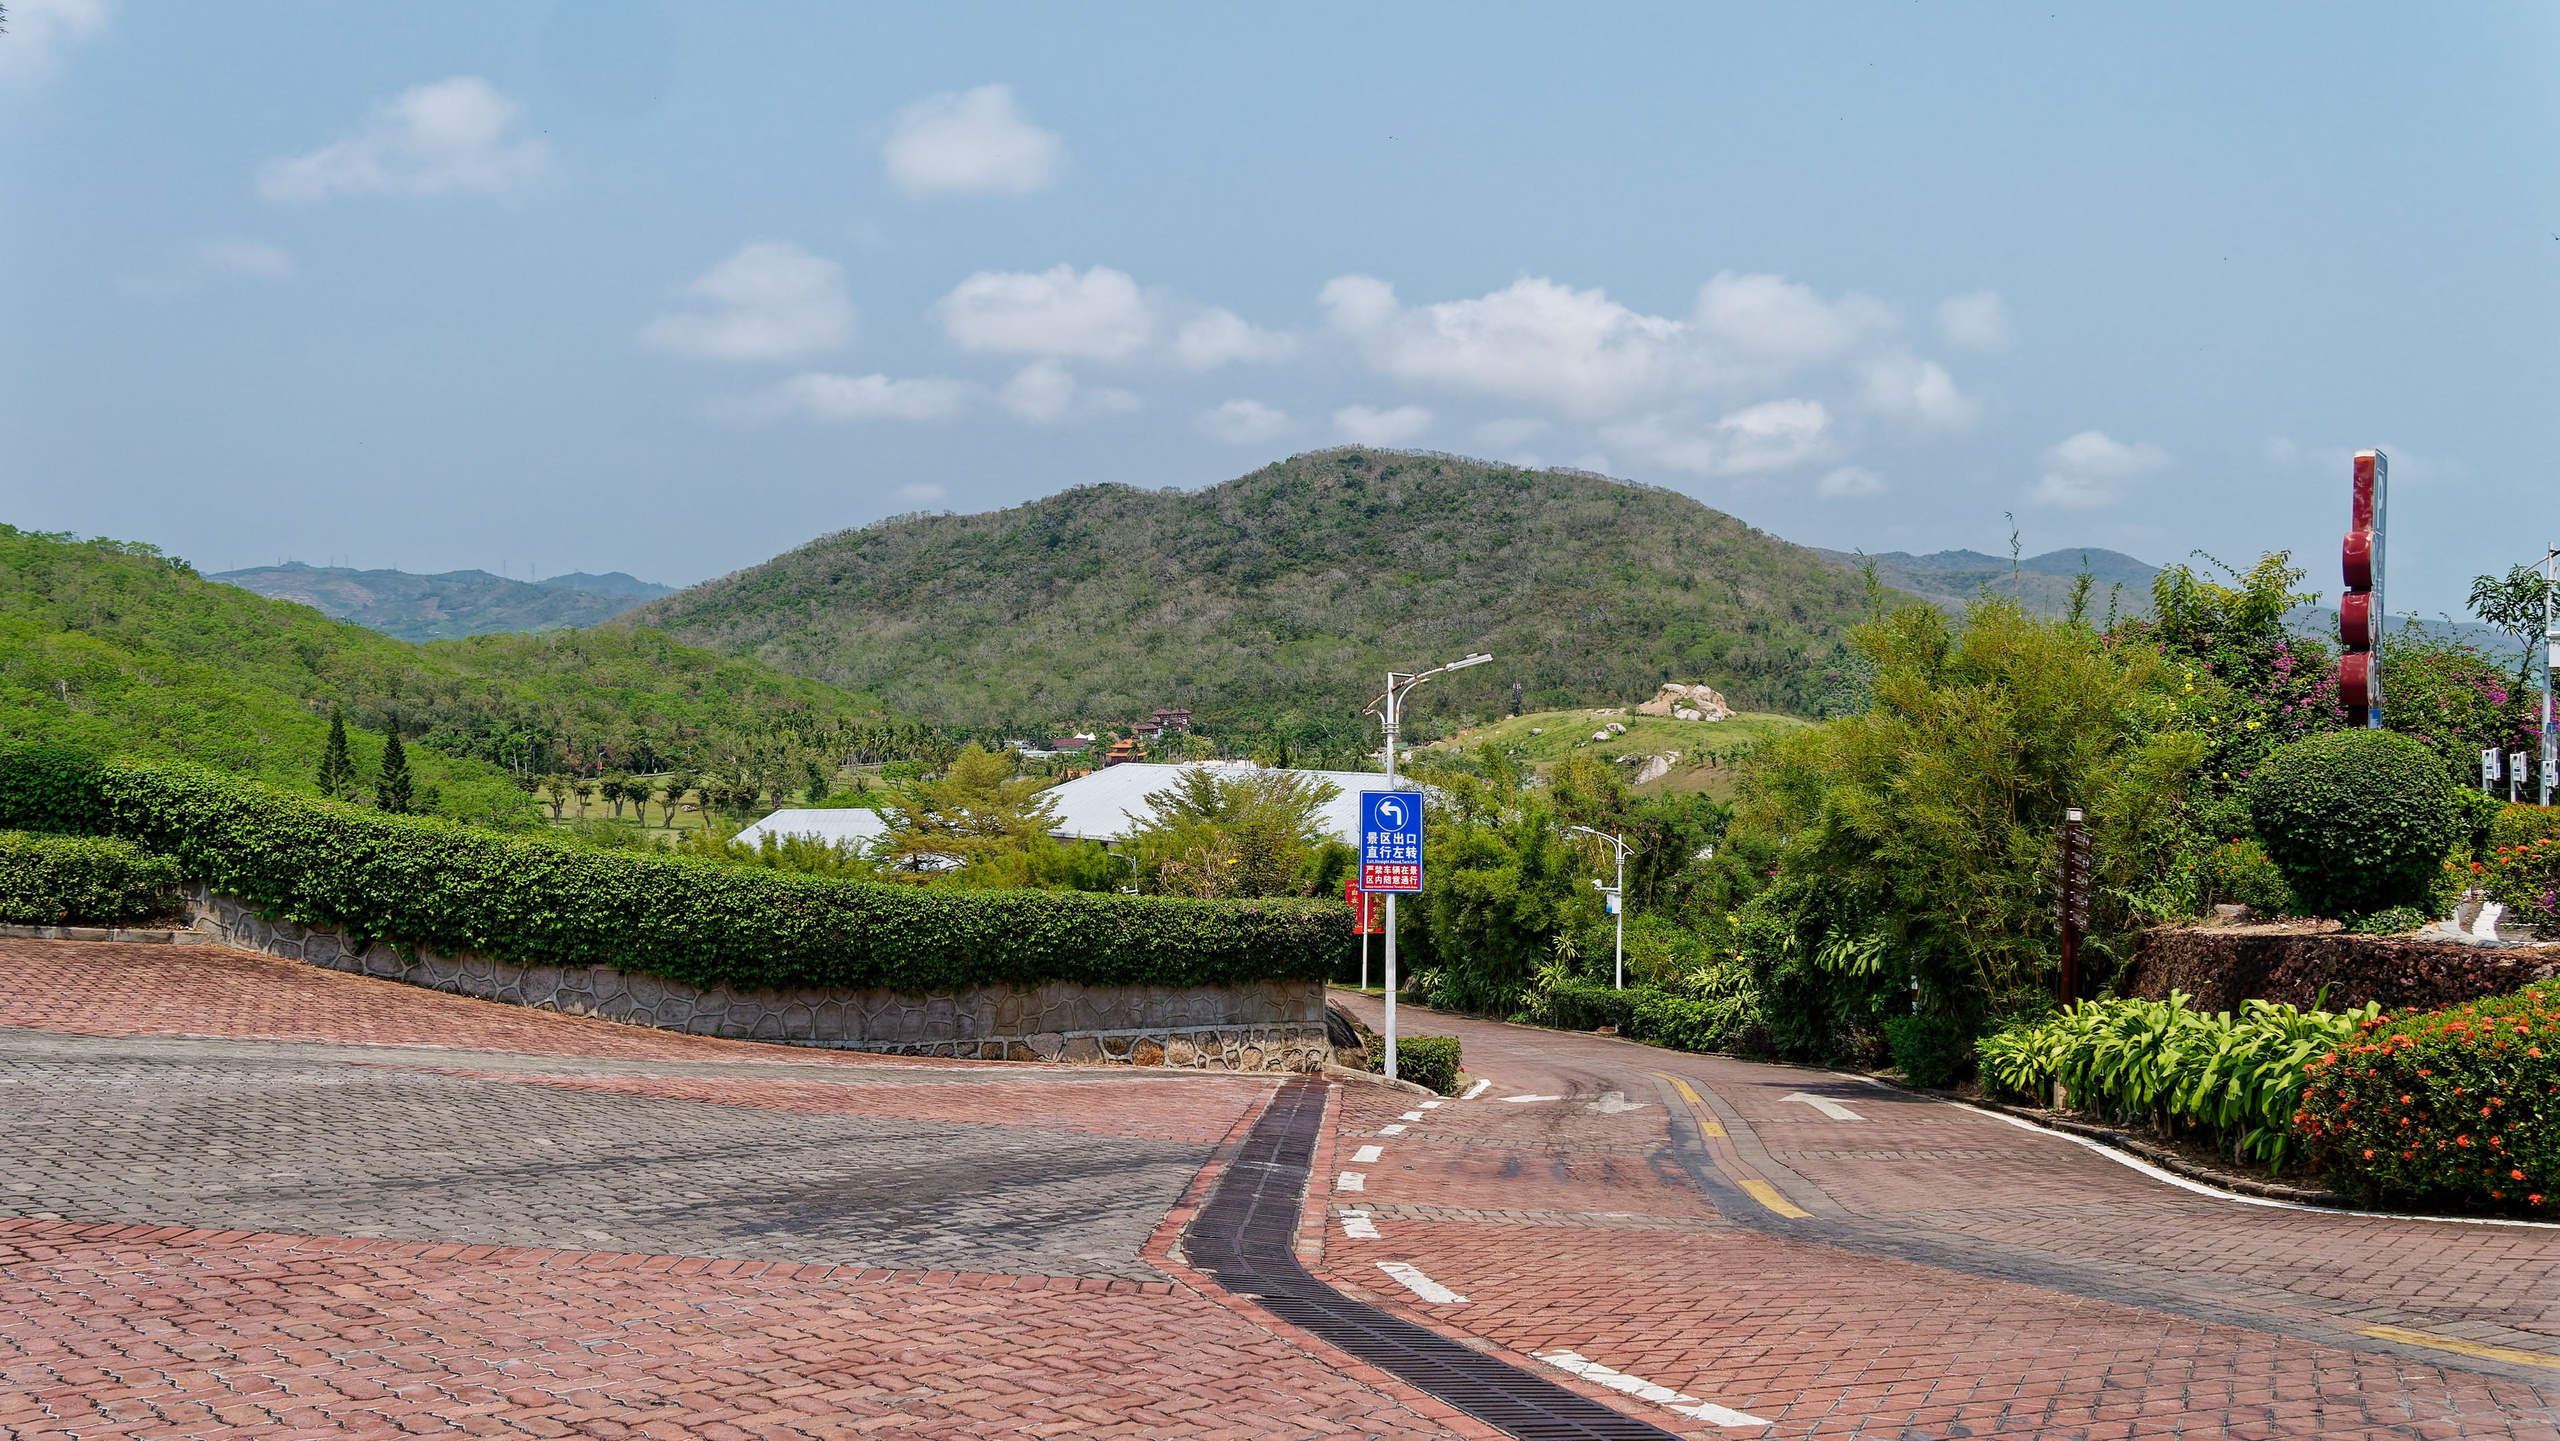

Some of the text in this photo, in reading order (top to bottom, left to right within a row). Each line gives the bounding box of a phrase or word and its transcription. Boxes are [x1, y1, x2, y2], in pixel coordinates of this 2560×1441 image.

[2376, 474, 2384, 529] P
[1366, 832, 1417, 845] 景区出口
[1366, 846, 1418, 859] 直行左转
[1366, 865, 1417, 875] 严禁车辆在景
[1366, 875, 1417, 885] 区内随意通行
